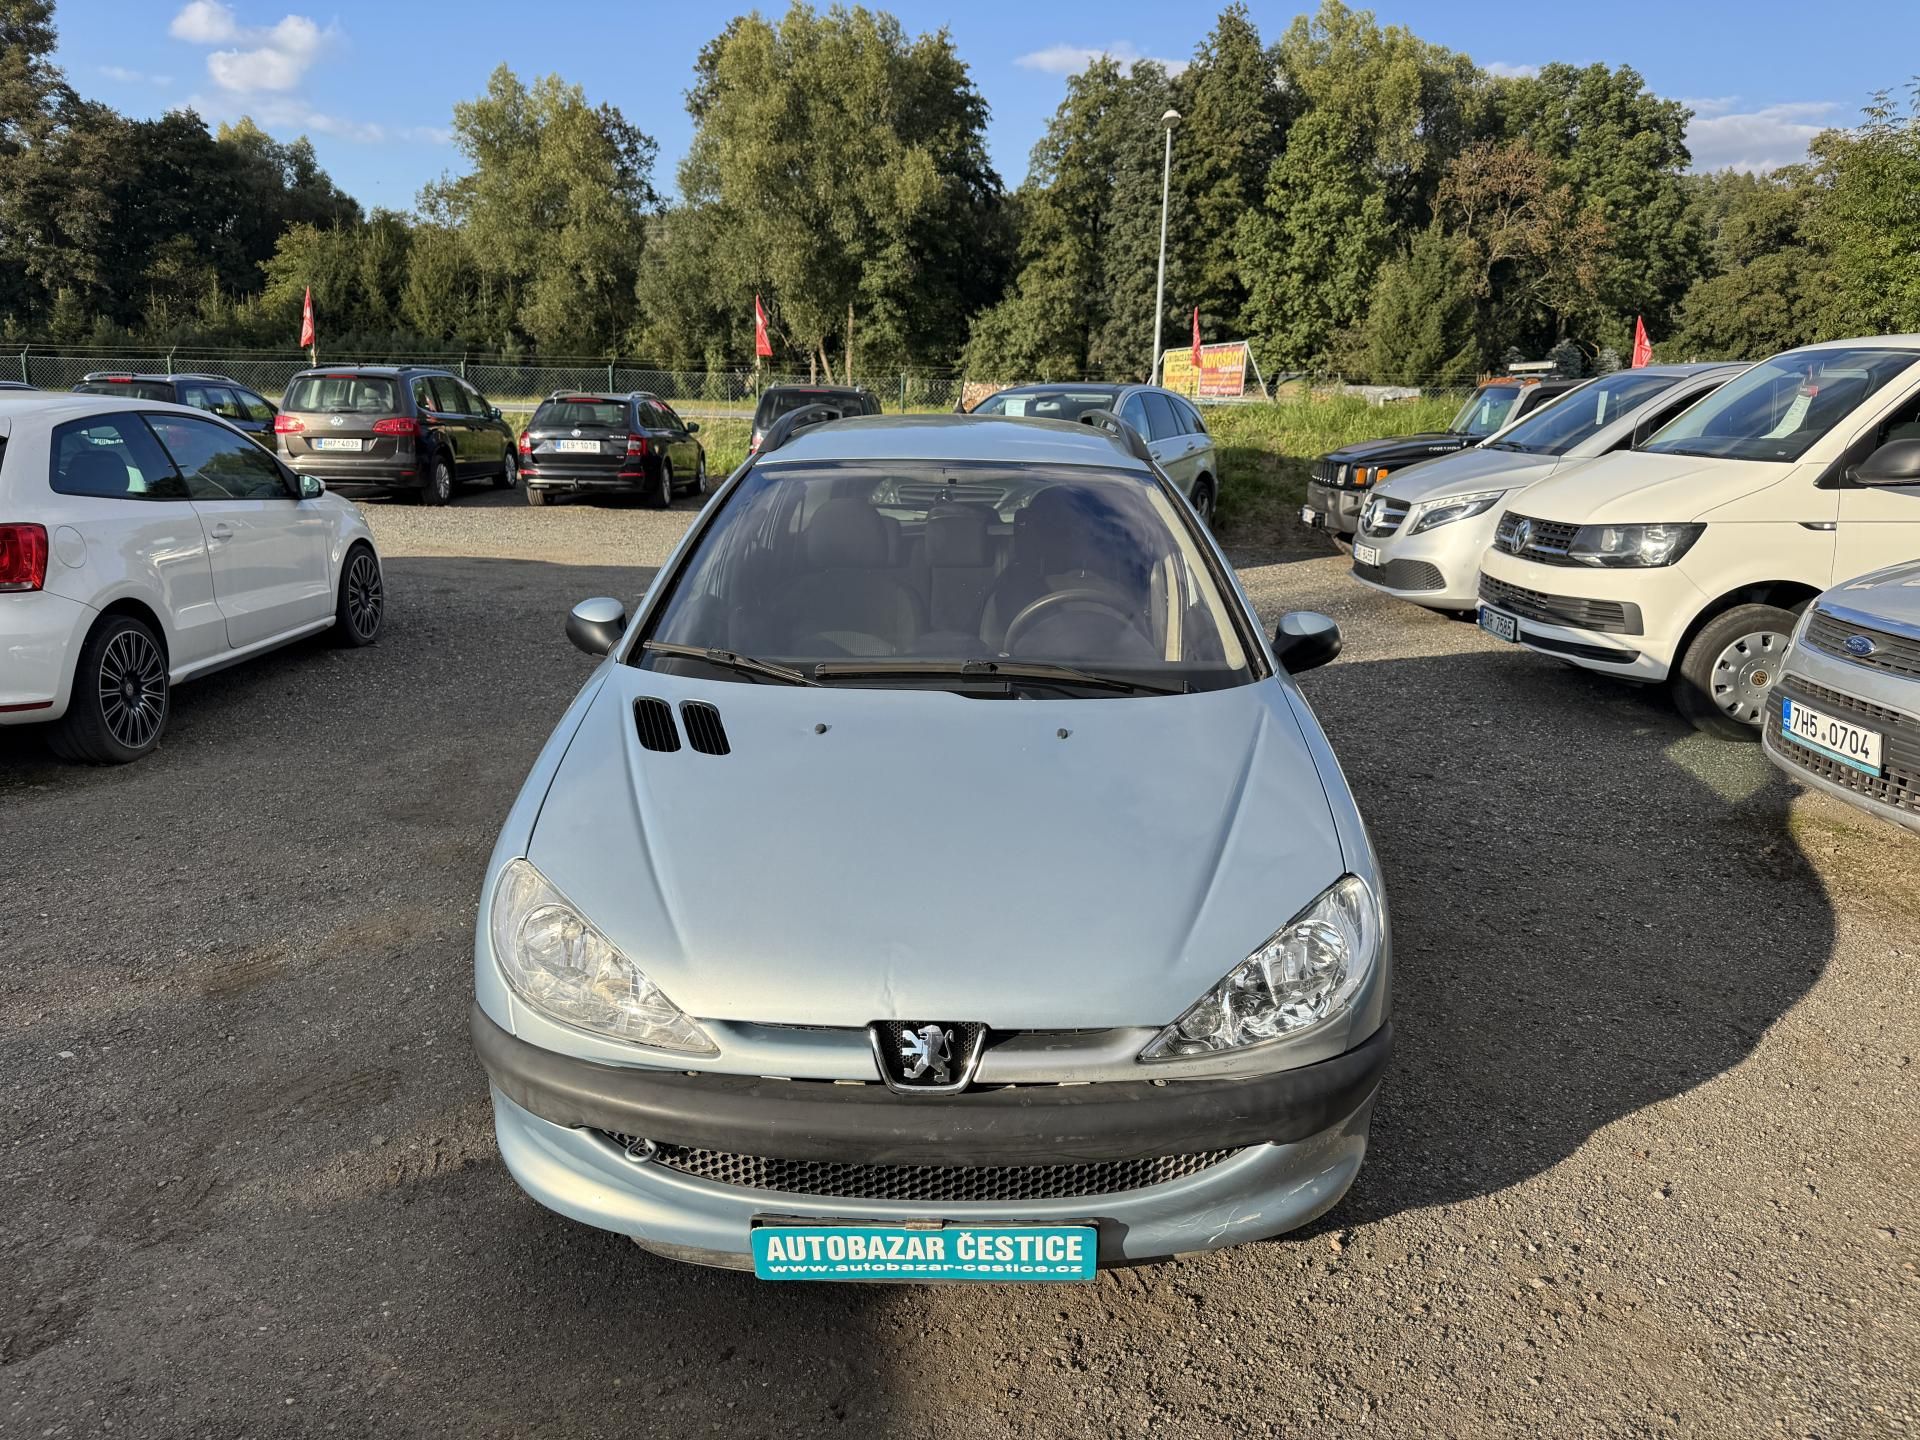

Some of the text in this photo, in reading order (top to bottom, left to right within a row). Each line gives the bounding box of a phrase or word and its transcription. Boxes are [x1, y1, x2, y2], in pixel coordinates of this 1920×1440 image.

[1793, 706, 1870, 760] 7H5 0704
[767, 1231, 1083, 1262] AUTOBAZAR ČESTICE
[768, 1263, 1083, 1274] www.autobazar-cestice.cz
